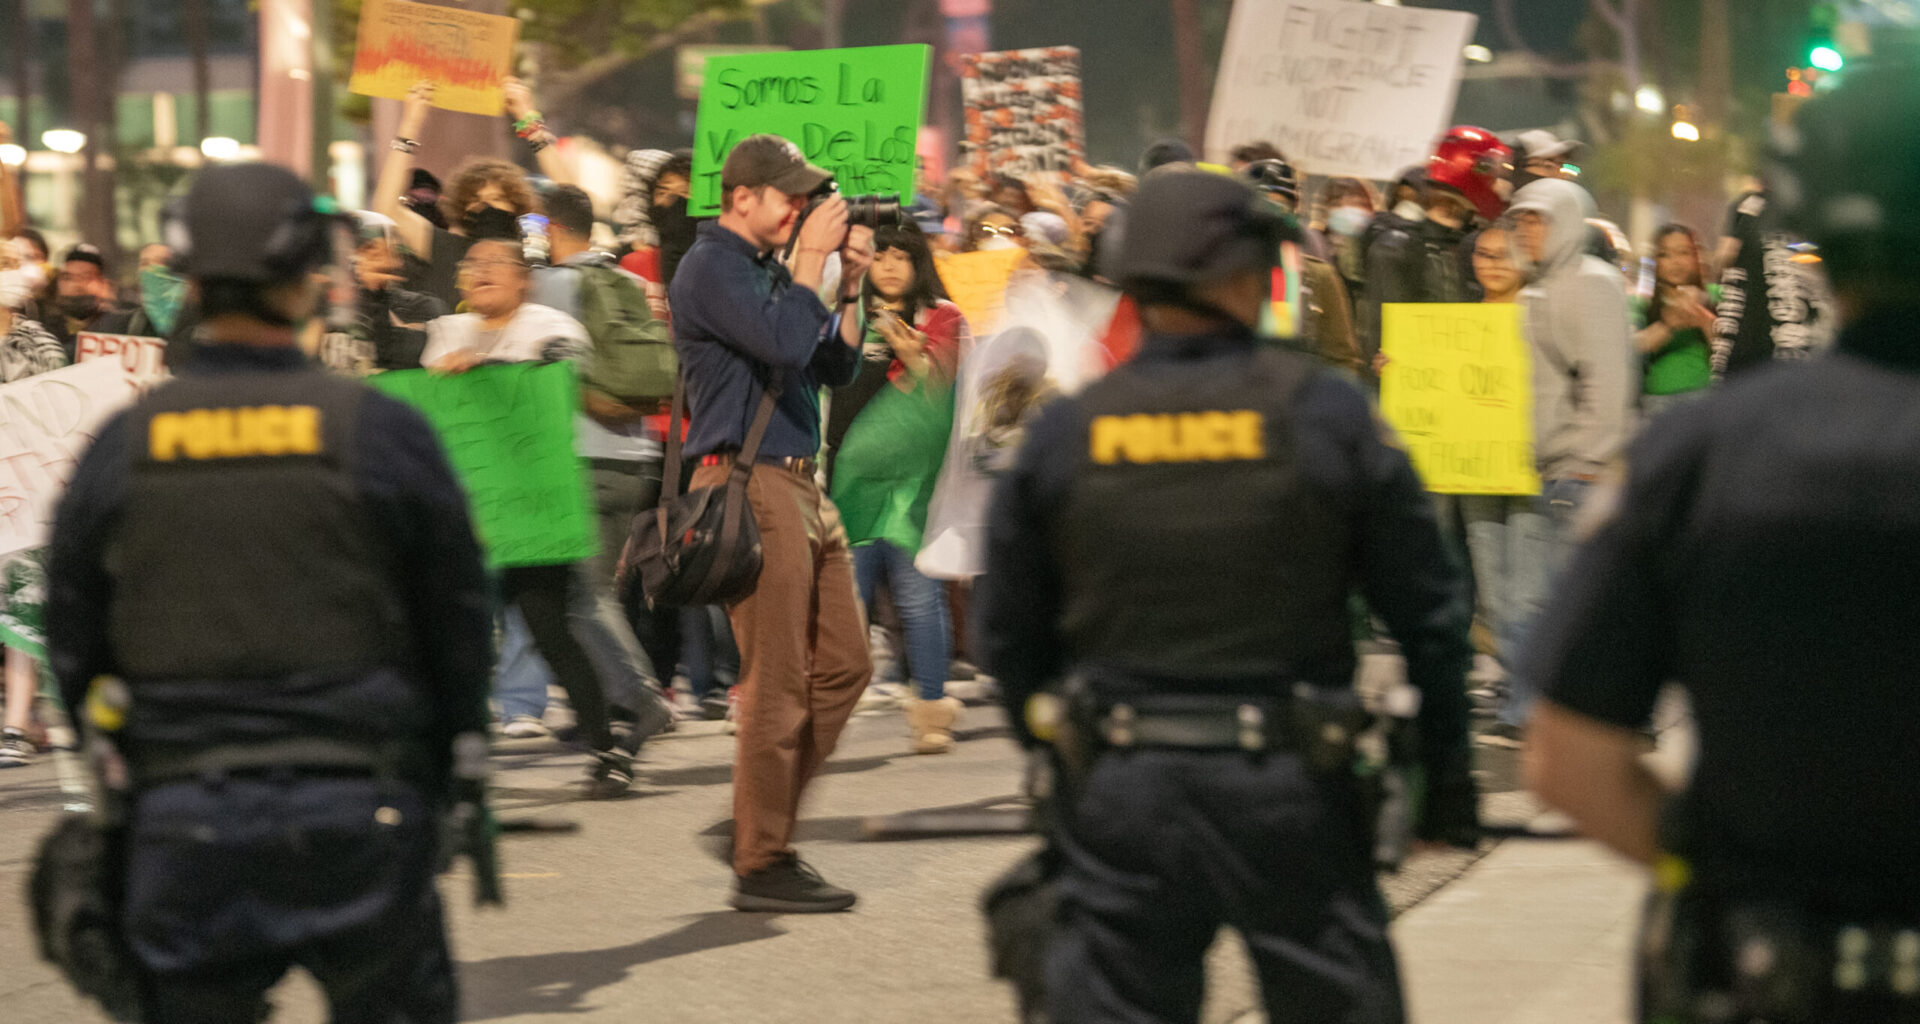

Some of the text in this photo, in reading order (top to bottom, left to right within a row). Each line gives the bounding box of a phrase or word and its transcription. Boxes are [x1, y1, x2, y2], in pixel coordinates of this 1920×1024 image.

[1279, 5, 1427, 63] FIGHT
[718, 62, 884, 109] Somos La
[1412, 314, 1497, 360] THEY
[150, 405, 323, 462] POLICE
[1090, 409, 1265, 465] POLICE
